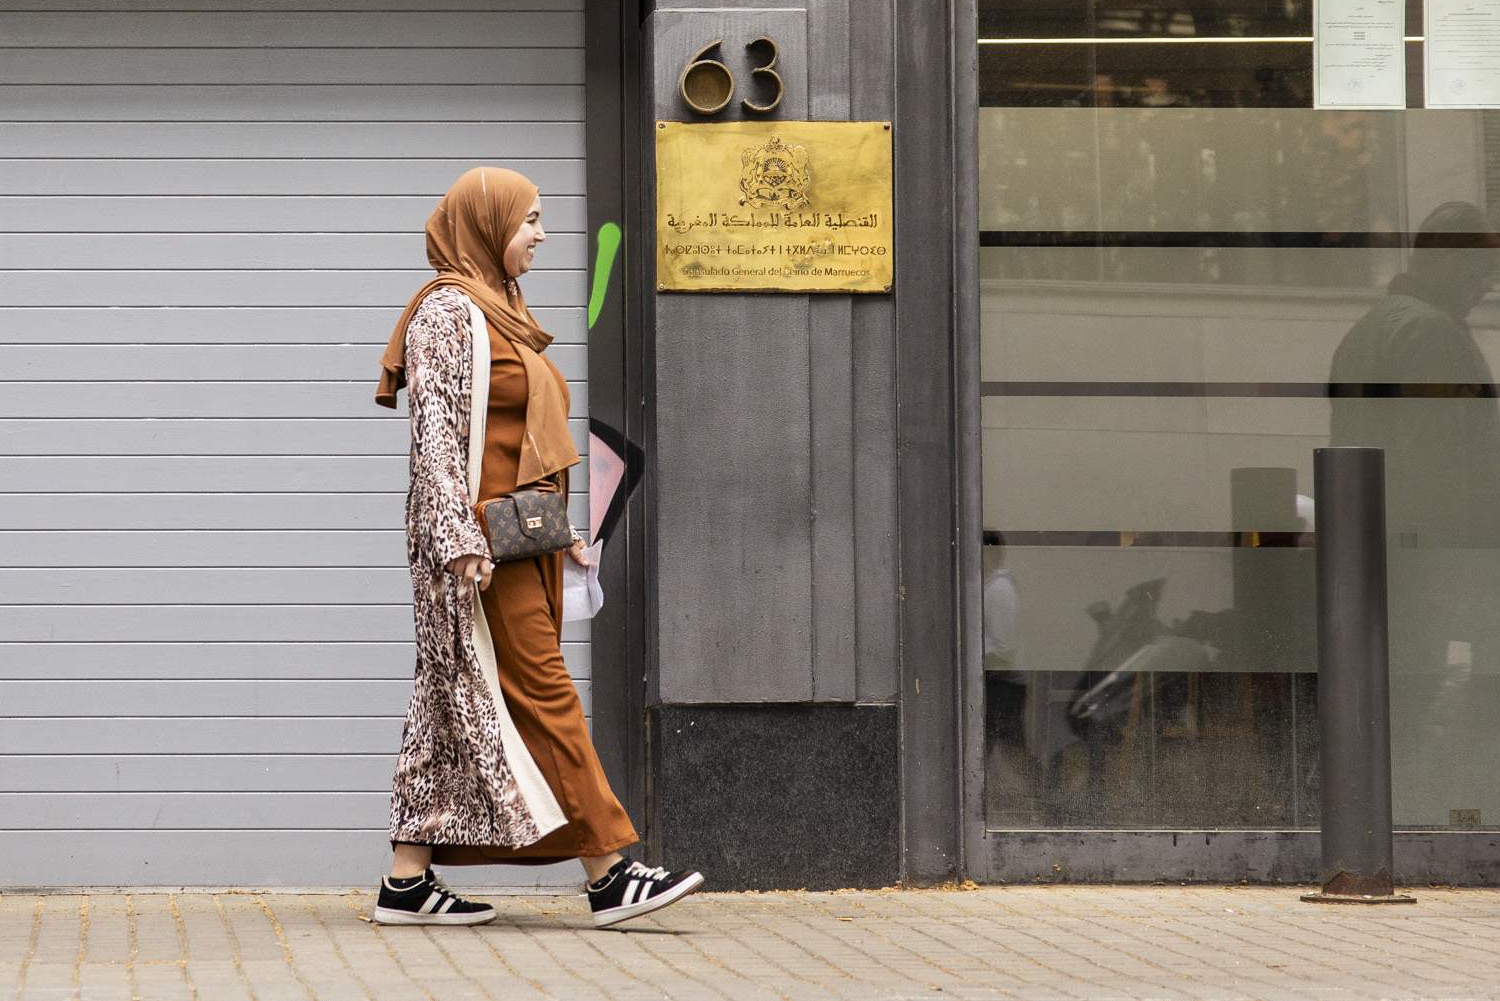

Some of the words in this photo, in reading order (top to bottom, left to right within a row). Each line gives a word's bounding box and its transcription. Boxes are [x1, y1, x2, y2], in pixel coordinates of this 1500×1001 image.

[680, 36, 784, 113] 63
[784, 212, 821, 228] العامة
[825, 213, 878, 230] القنصلية
[732, 266, 766, 276] General
[768, 266, 782, 276] del
[784, 266, 810, 277] eino
[811, 267, 823, 276] de
[824, 267, 870, 277] Marruecos
